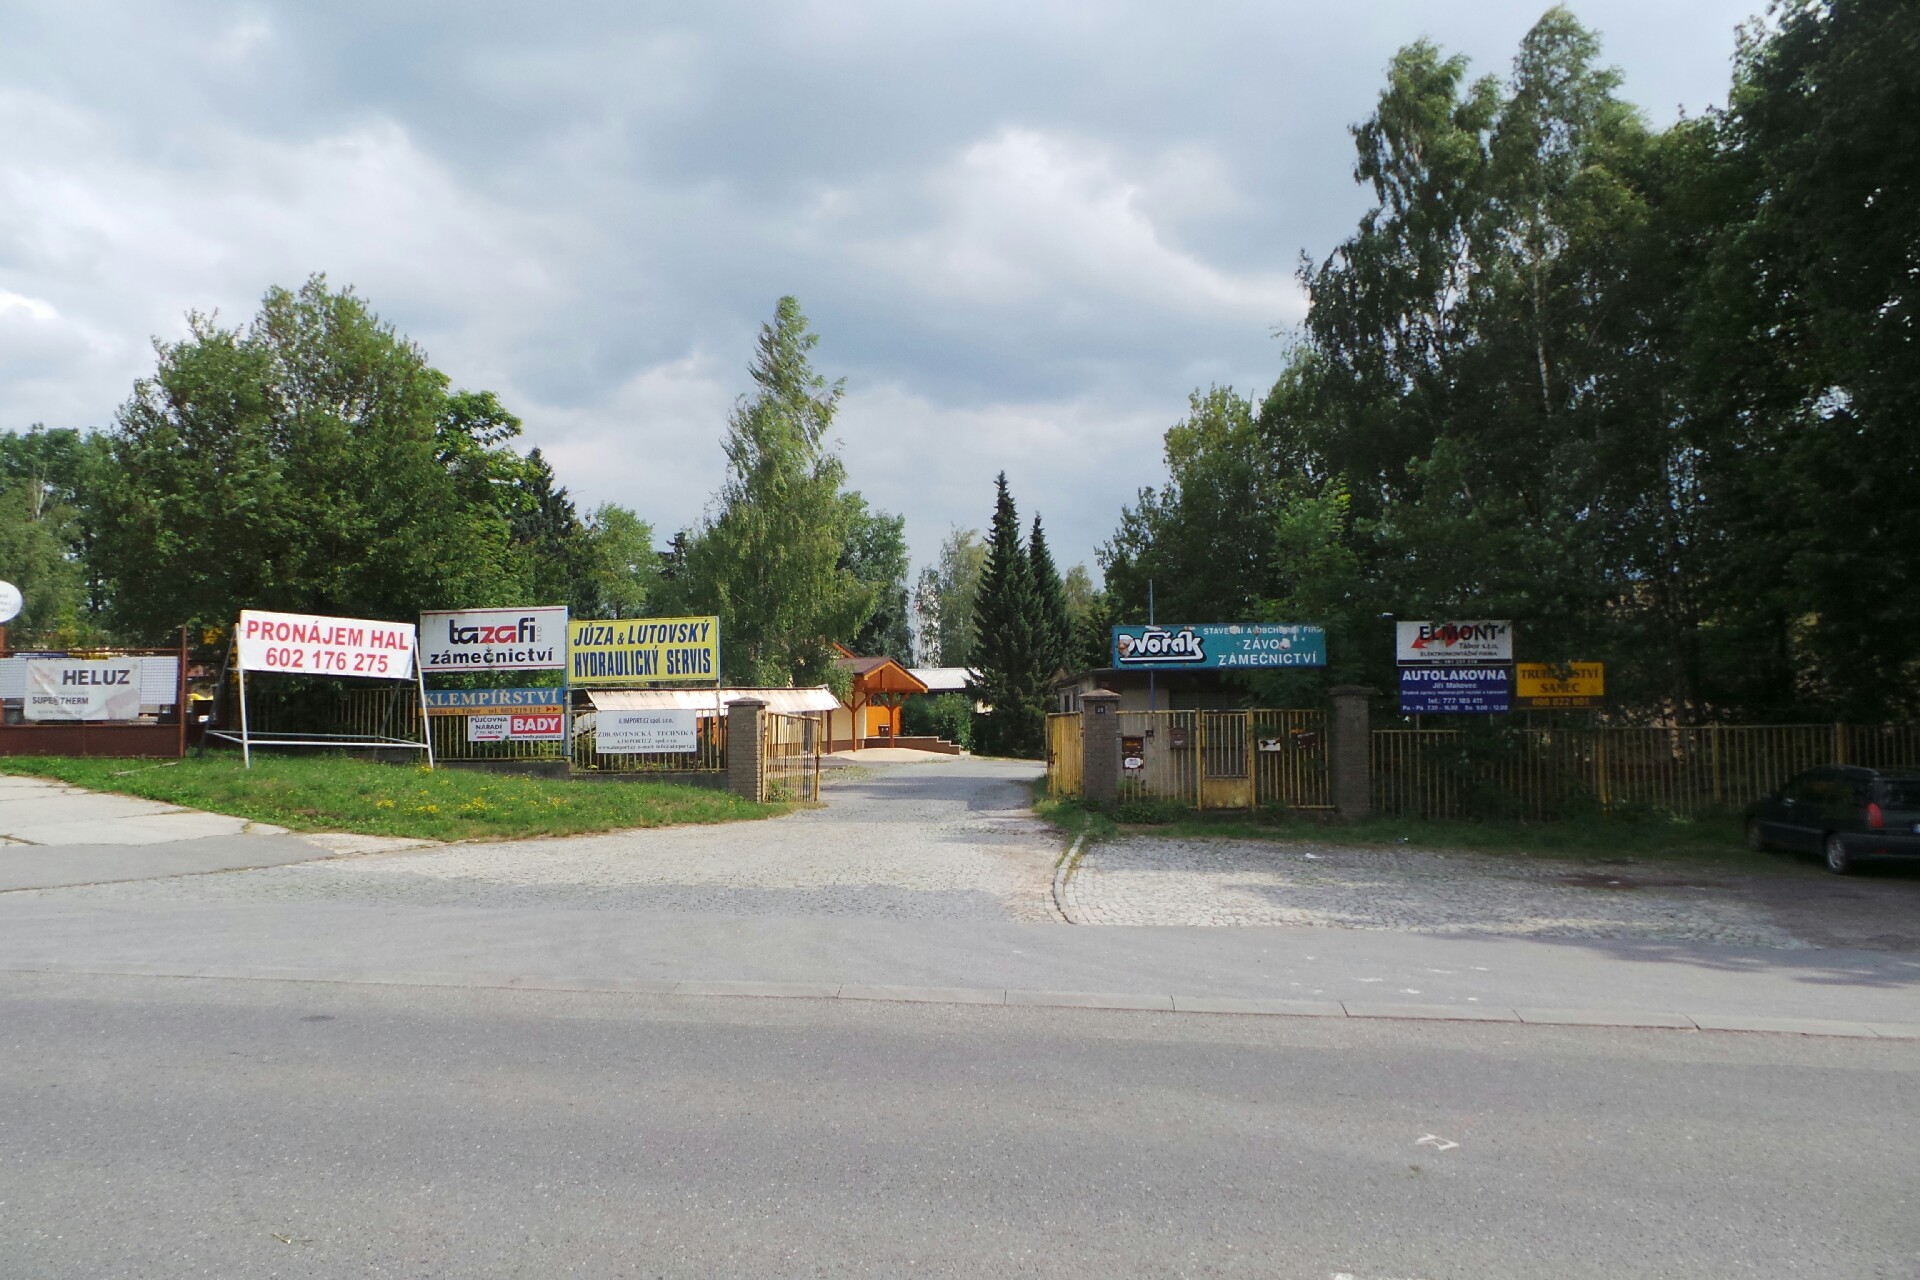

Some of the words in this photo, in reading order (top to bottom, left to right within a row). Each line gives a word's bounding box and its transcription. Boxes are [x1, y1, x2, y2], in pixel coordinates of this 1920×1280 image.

[246, 619, 363, 647] PRONÁJEM
[370, 630, 409, 650] HAL
[449, 617, 536, 645] tazafi
[574, 622, 614, 646] JŮZA
[617, 632, 625, 645] &
[628, 619, 710, 645] LUTOVSKÝ
[1243, 637, 1290, 650] ZÁVO
[266, 648, 304, 668] 602
[312, 650, 347, 671] 176
[354, 653, 389, 673] 275
[430, 647, 554, 665] zámečnictví
[574, 645, 659, 677] HYDRAULICKÝ
[667, 648, 711, 675] SERVIS
[1218, 650, 1316, 666] ZÁMEČNICTVÍ
[62, 669, 131, 686] HELUZ
[1402, 669, 1507, 681] AUTOLAKOVNA
[425, 687, 558, 706] KLEMPÍŘSTVÍ
[513, 718, 559, 731] BADY
[598, 730, 652, 738] ZDRAVOTNICKÁ
